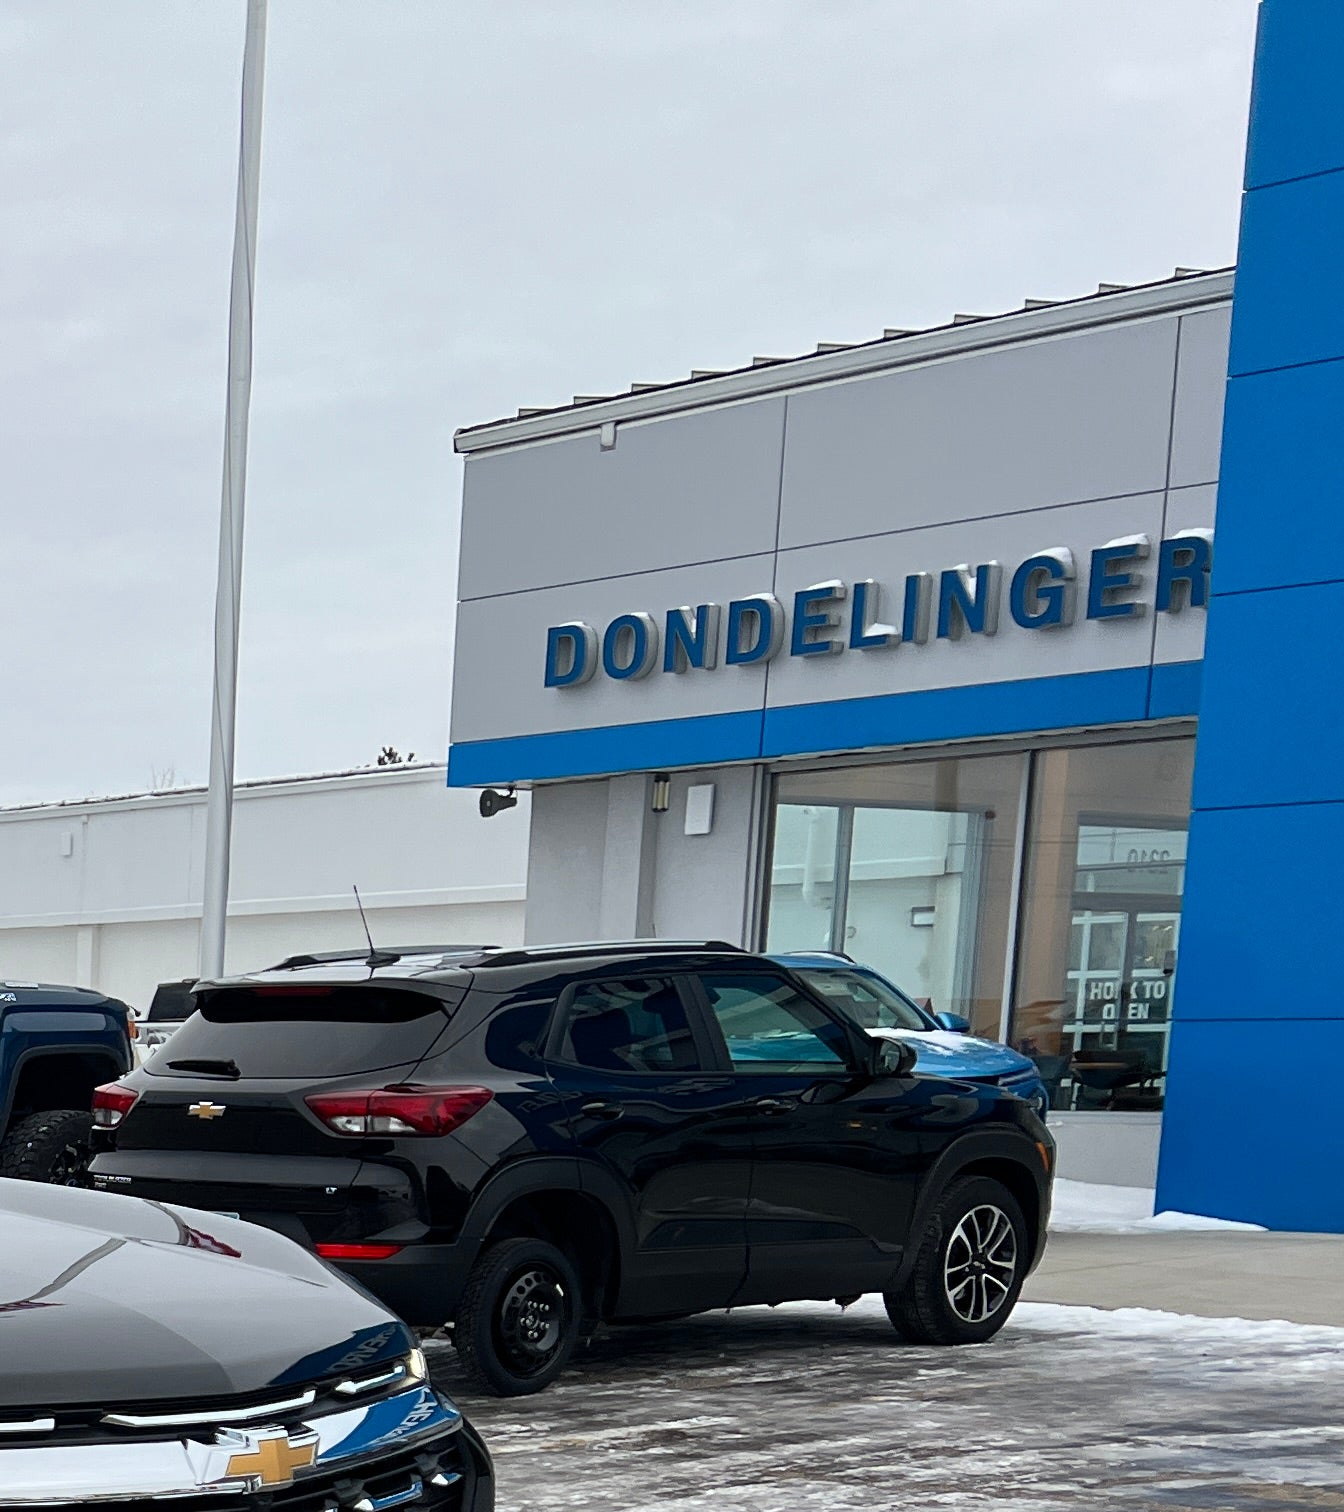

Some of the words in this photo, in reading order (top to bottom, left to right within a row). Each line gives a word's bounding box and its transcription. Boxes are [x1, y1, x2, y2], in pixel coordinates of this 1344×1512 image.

[544, 531, 1213, 687] DONDELINGER
[1143, 980, 1166, 999] TO
[1102, 1002, 1150, 1020] OEN
